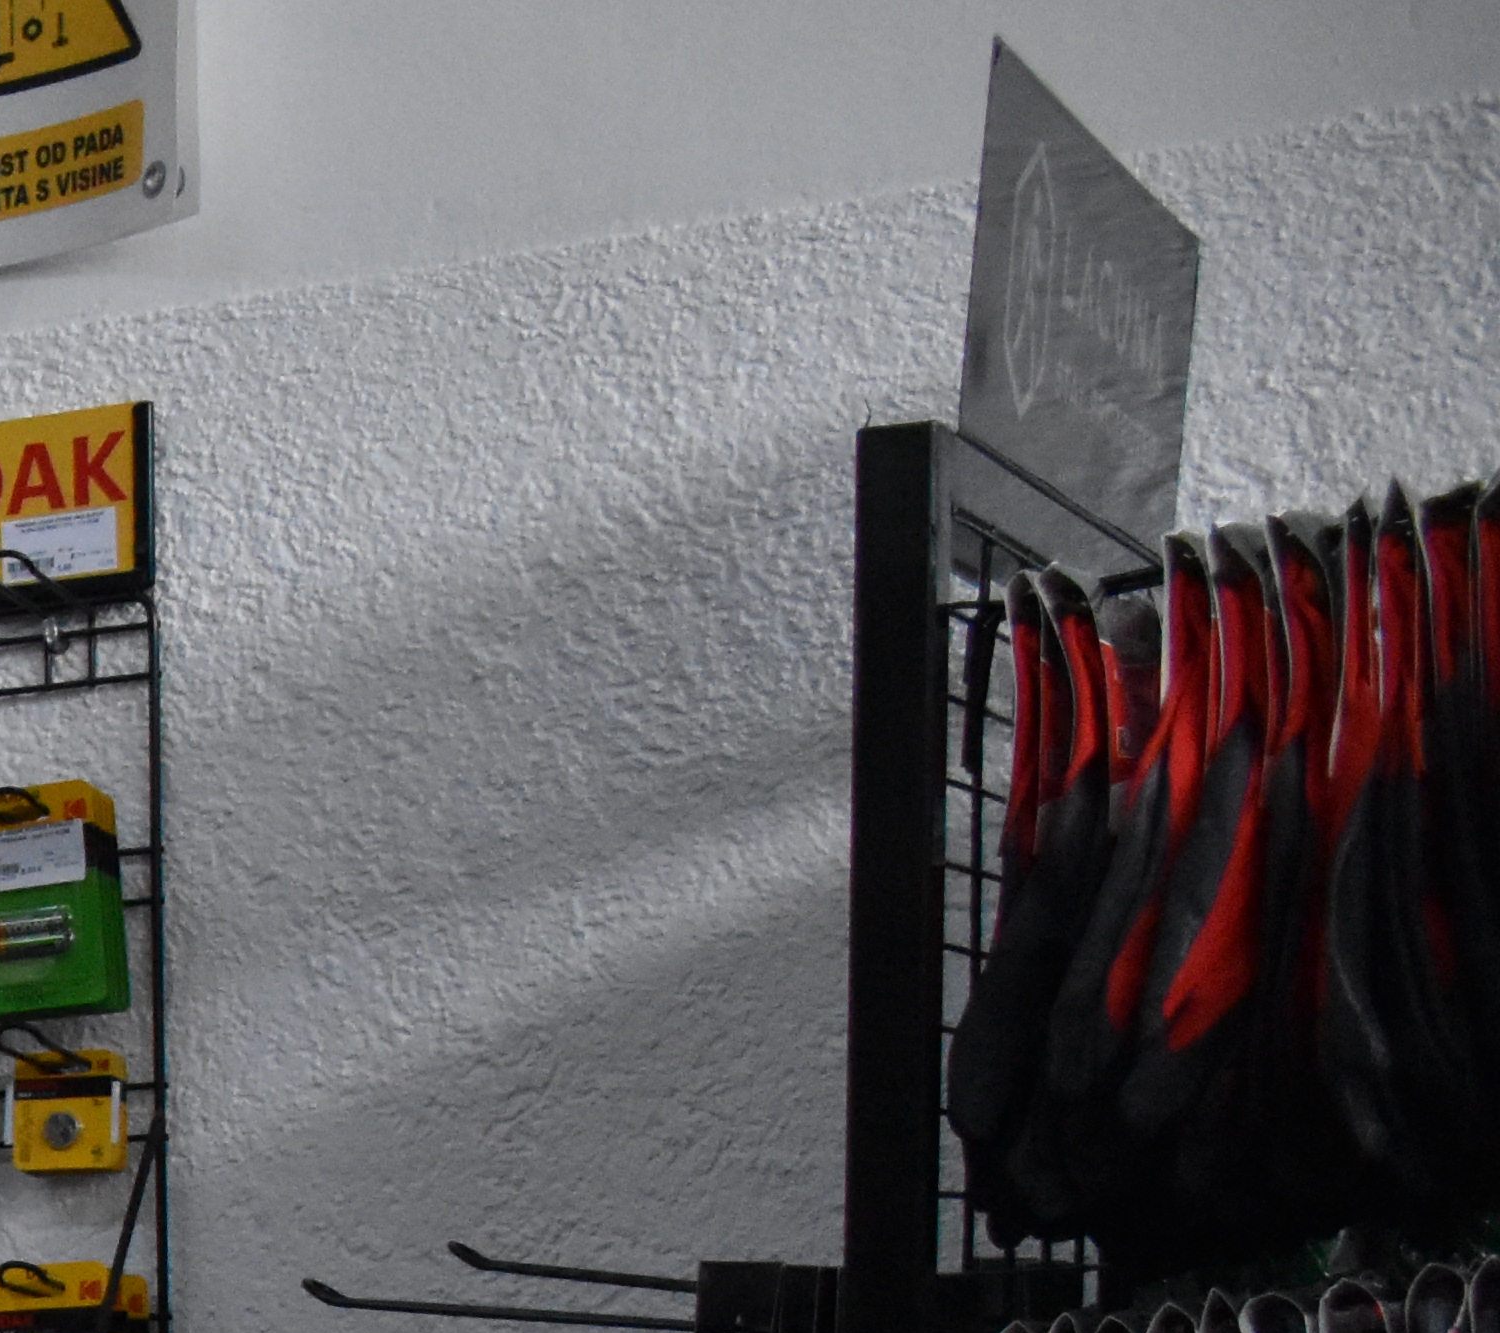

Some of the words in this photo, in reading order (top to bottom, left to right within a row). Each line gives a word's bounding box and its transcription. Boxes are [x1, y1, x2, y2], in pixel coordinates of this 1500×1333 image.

[34, 143, 68, 168] OD
[72, 123, 126, 159] PADA
[35, 178, 50, 204] S
[54, 157, 126, 199] VISINE
